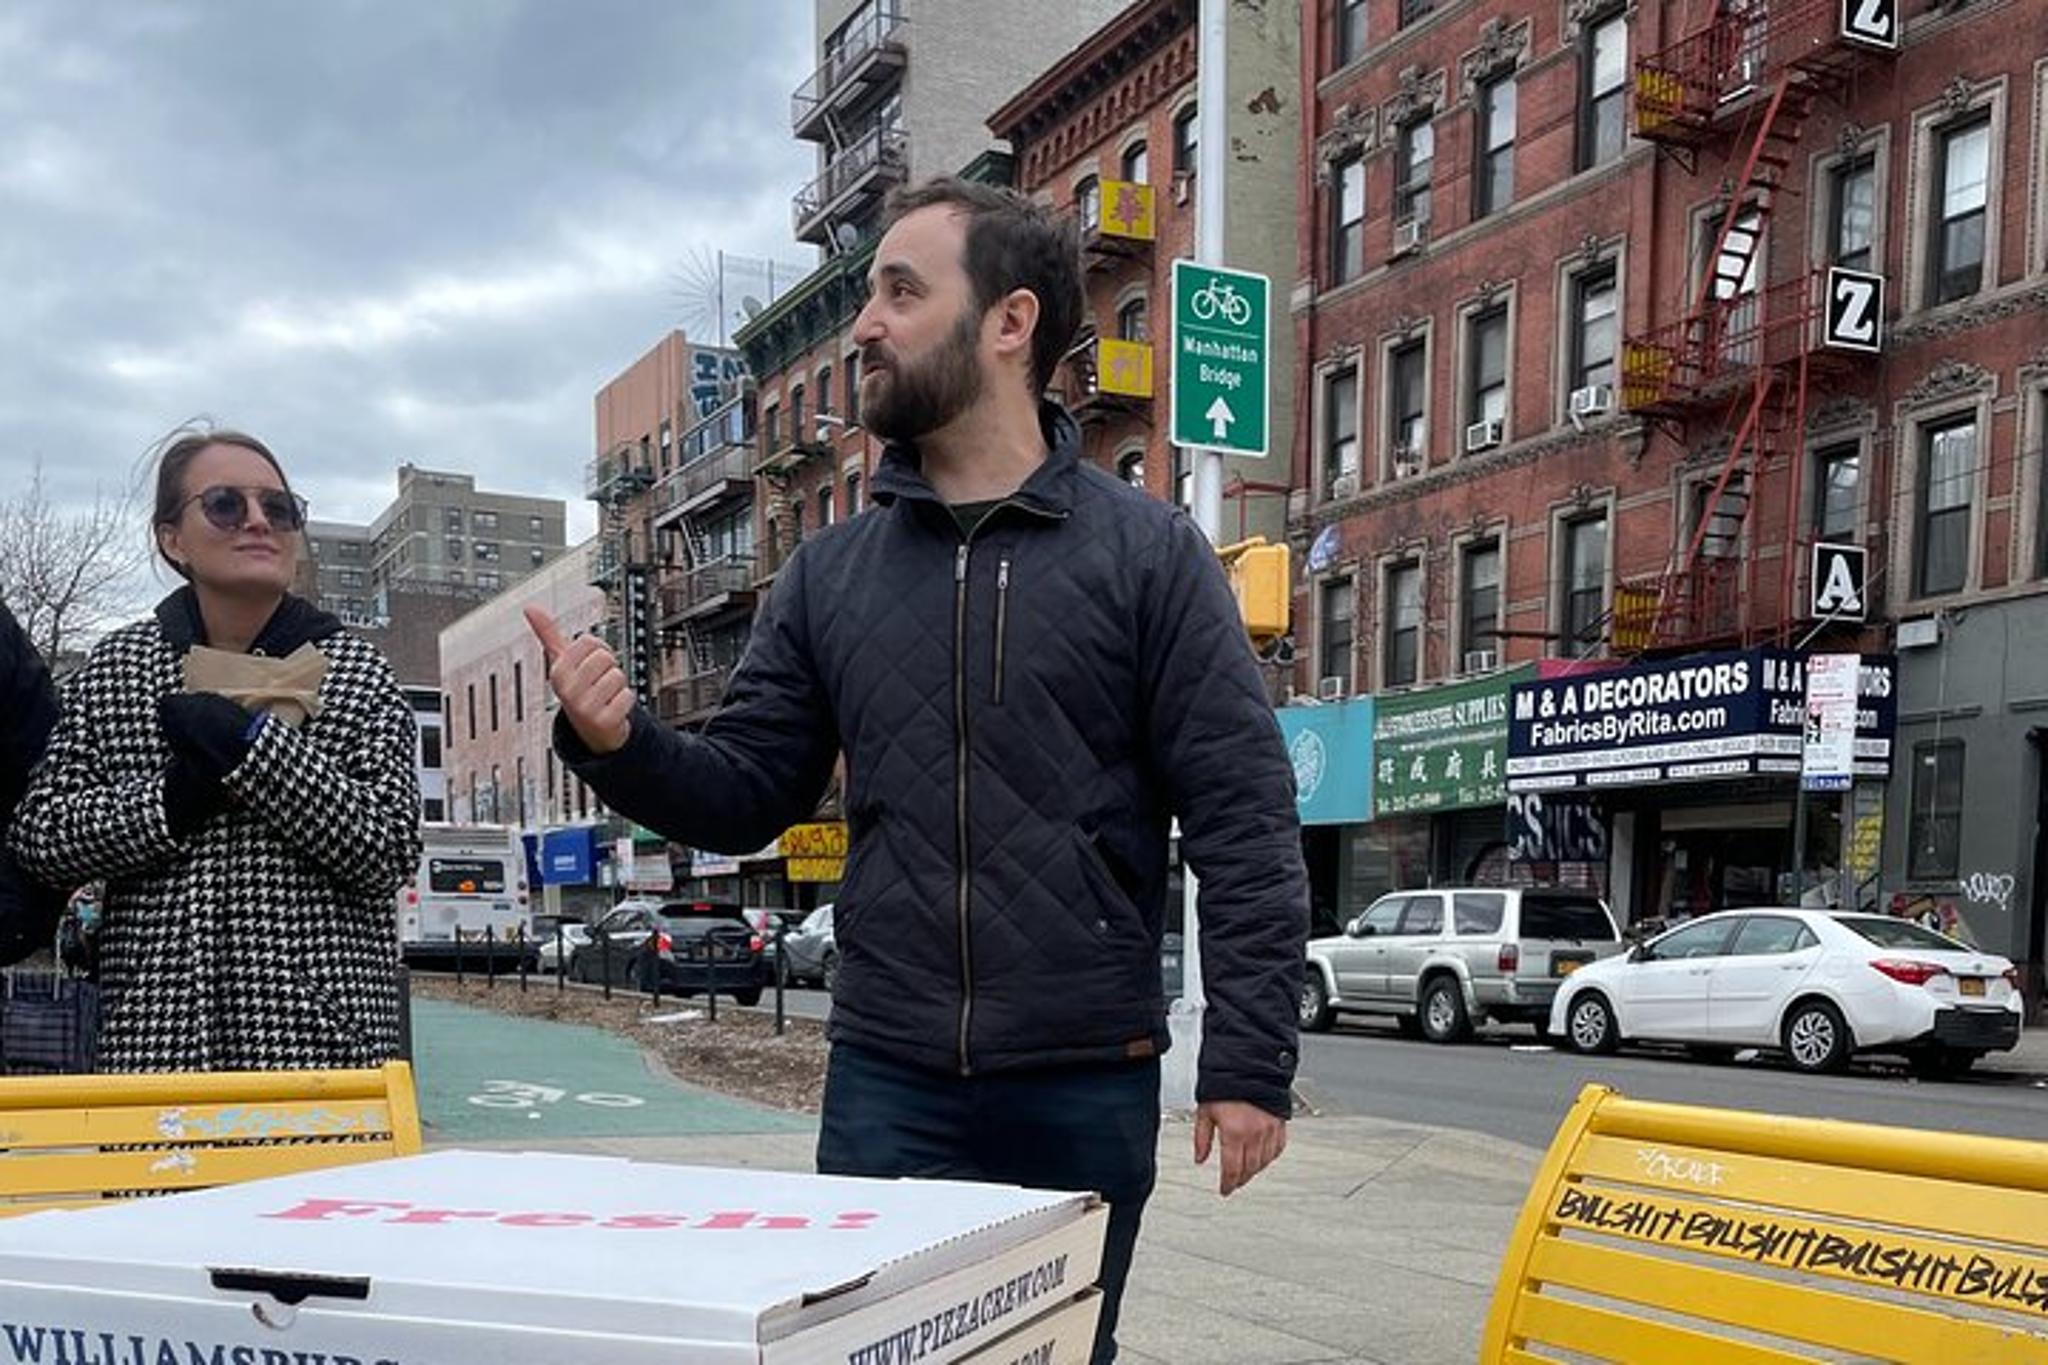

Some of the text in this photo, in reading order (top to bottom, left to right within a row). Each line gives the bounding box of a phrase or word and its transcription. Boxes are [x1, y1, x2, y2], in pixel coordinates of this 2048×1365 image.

[1835, 279, 1874, 343] Z
[1183, 336, 1258, 363] Manhattan
[1200, 363, 1242, 390] Bridge
[1817, 553, 1862, 610] A
[1515, 661, 1749, 720] M & A DECORATORS
[1531, 707, 1726, 747] FabricsByRita.com
[2, 1323, 400, 1365] WILLIAMS
